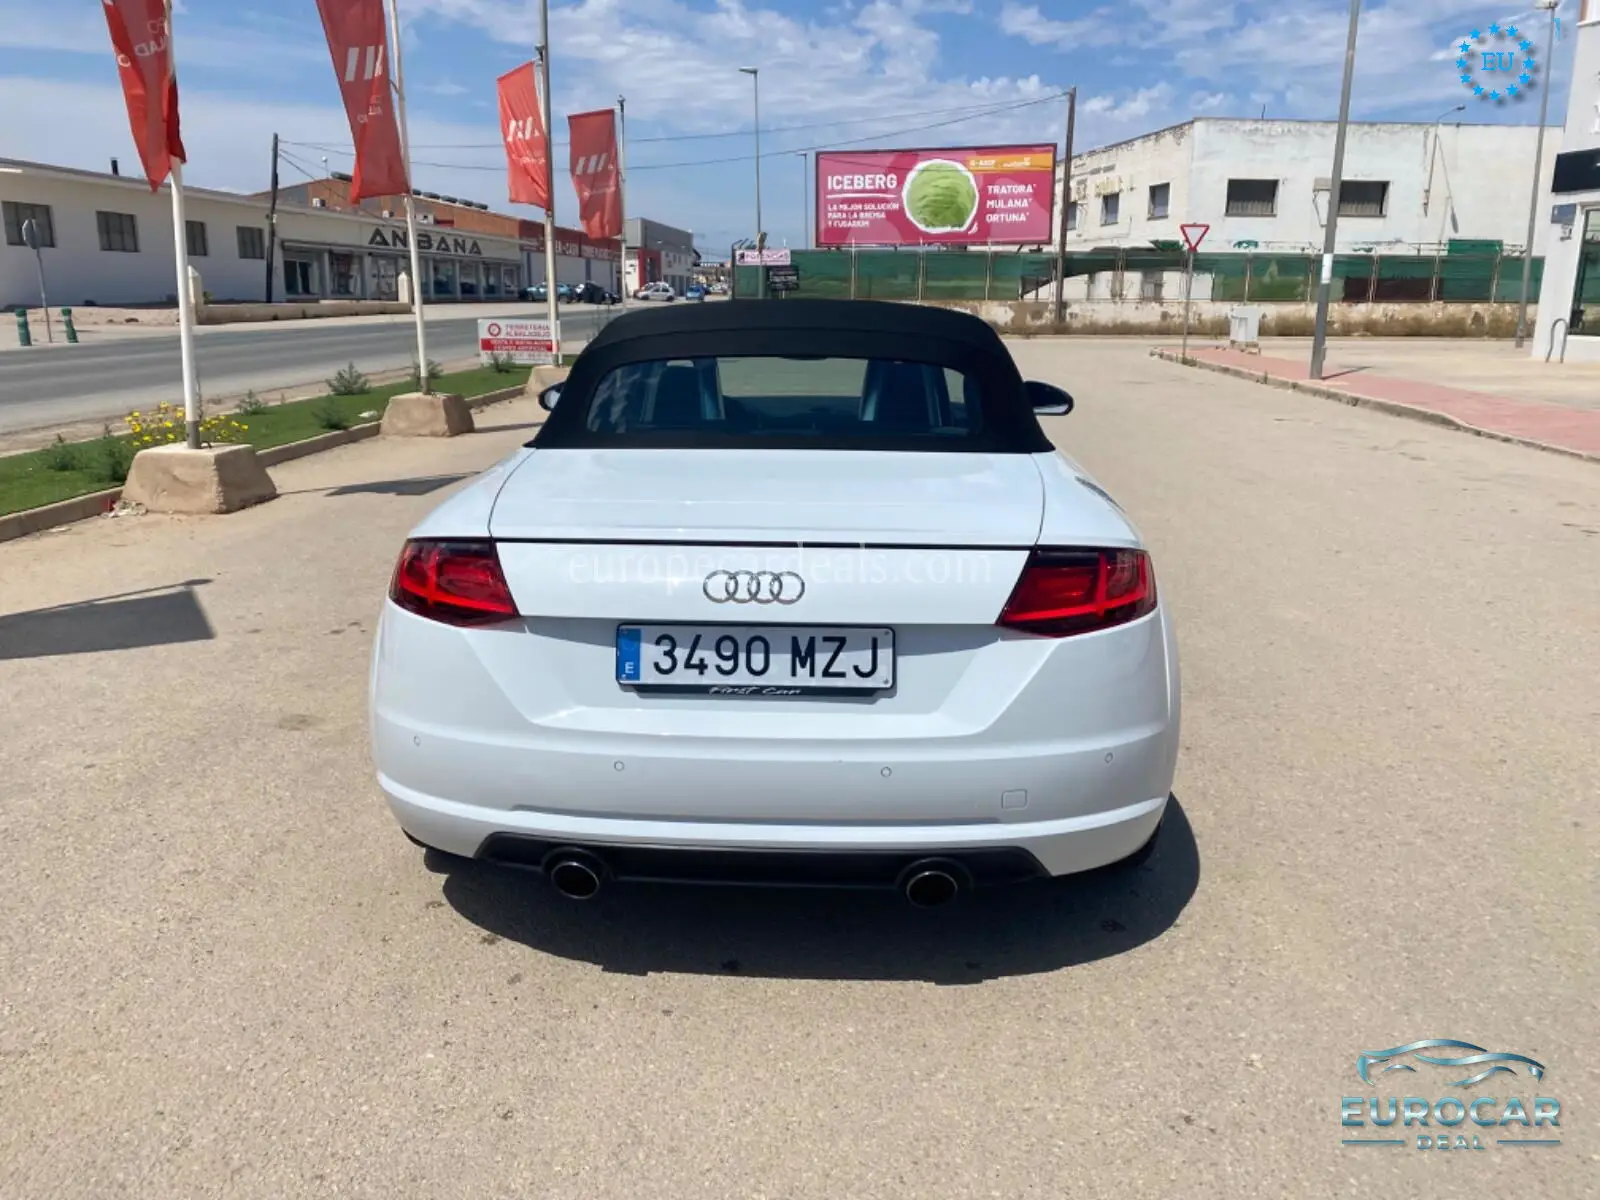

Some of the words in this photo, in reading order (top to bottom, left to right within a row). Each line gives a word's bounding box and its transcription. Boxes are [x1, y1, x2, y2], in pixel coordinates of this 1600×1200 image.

[827, 173, 898, 190] ICEBERG
[827, 203, 837, 211] LA
[653, 634, 771, 677] 3490
[790, 635, 879, 680] MZJ
